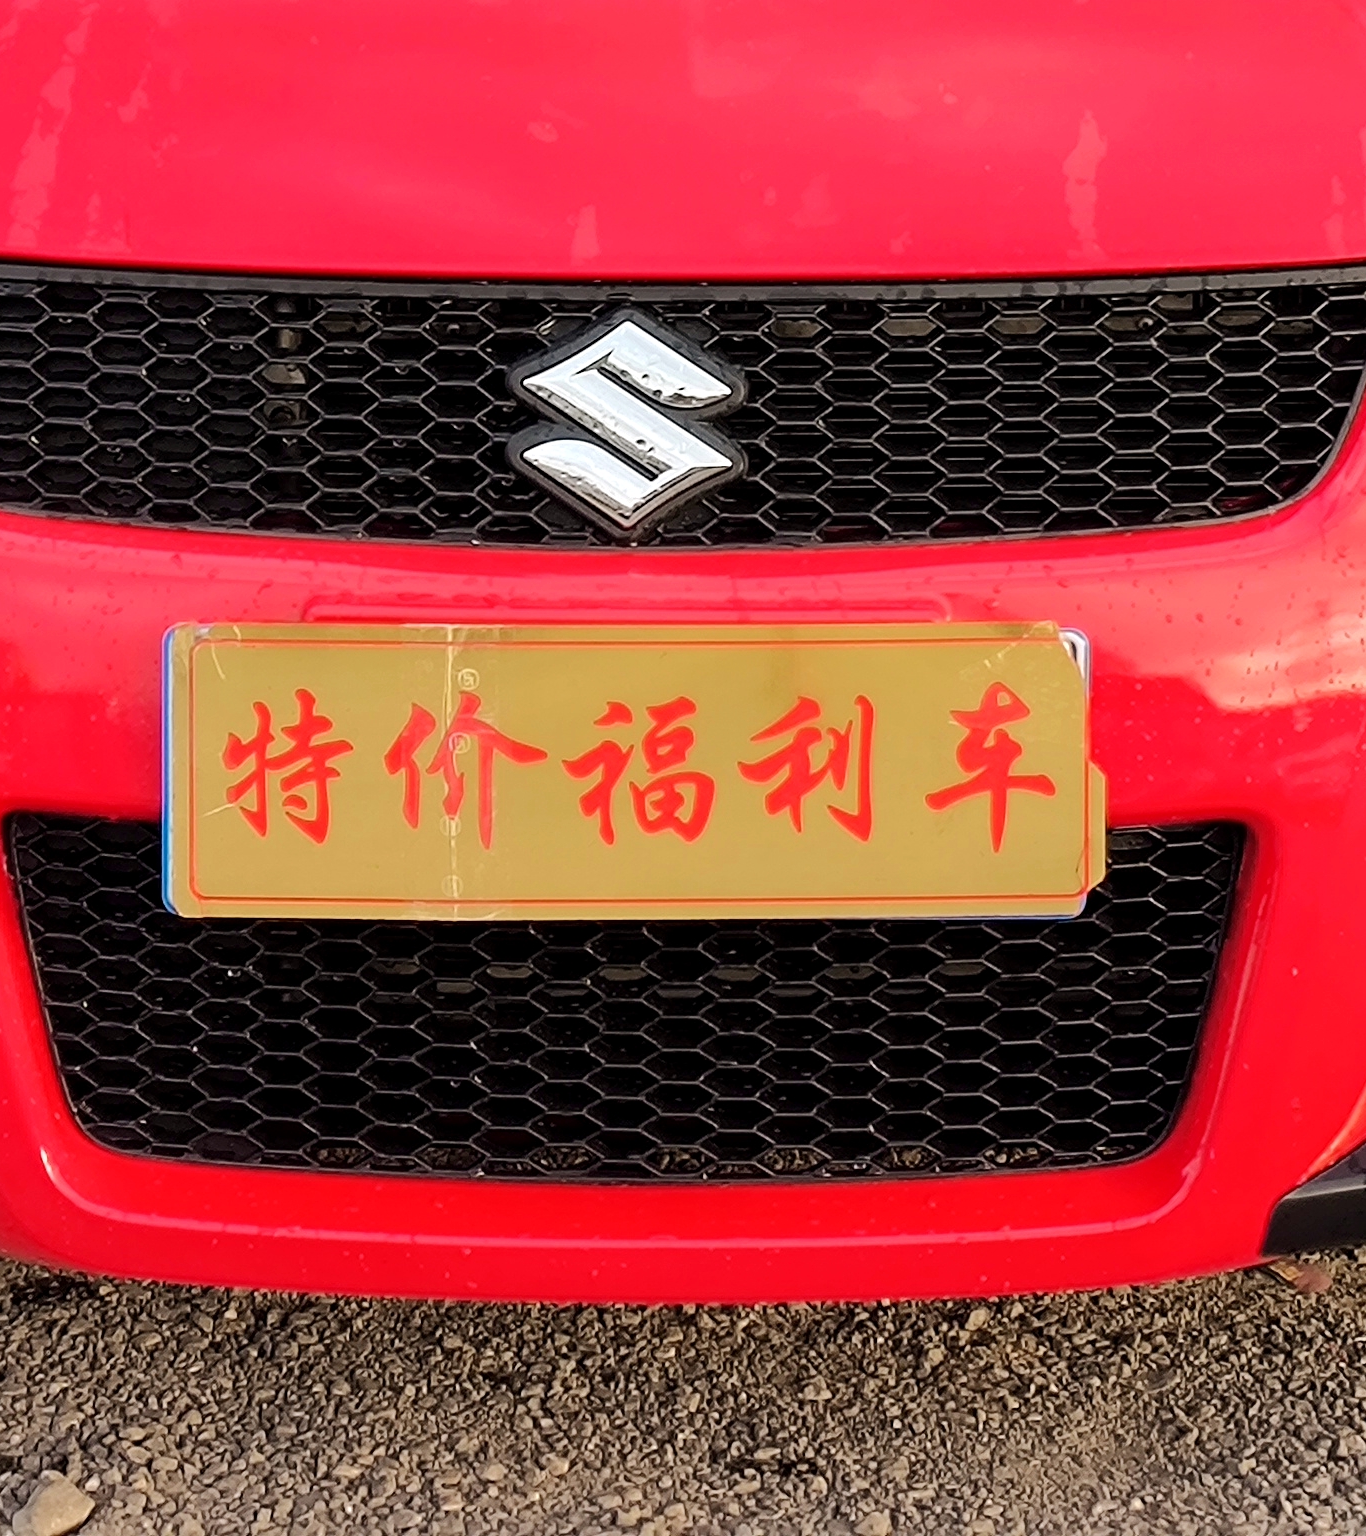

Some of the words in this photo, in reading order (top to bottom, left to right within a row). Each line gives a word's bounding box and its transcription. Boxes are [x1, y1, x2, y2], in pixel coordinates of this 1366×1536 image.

[222, 683, 1057, 853] 特价福利车
